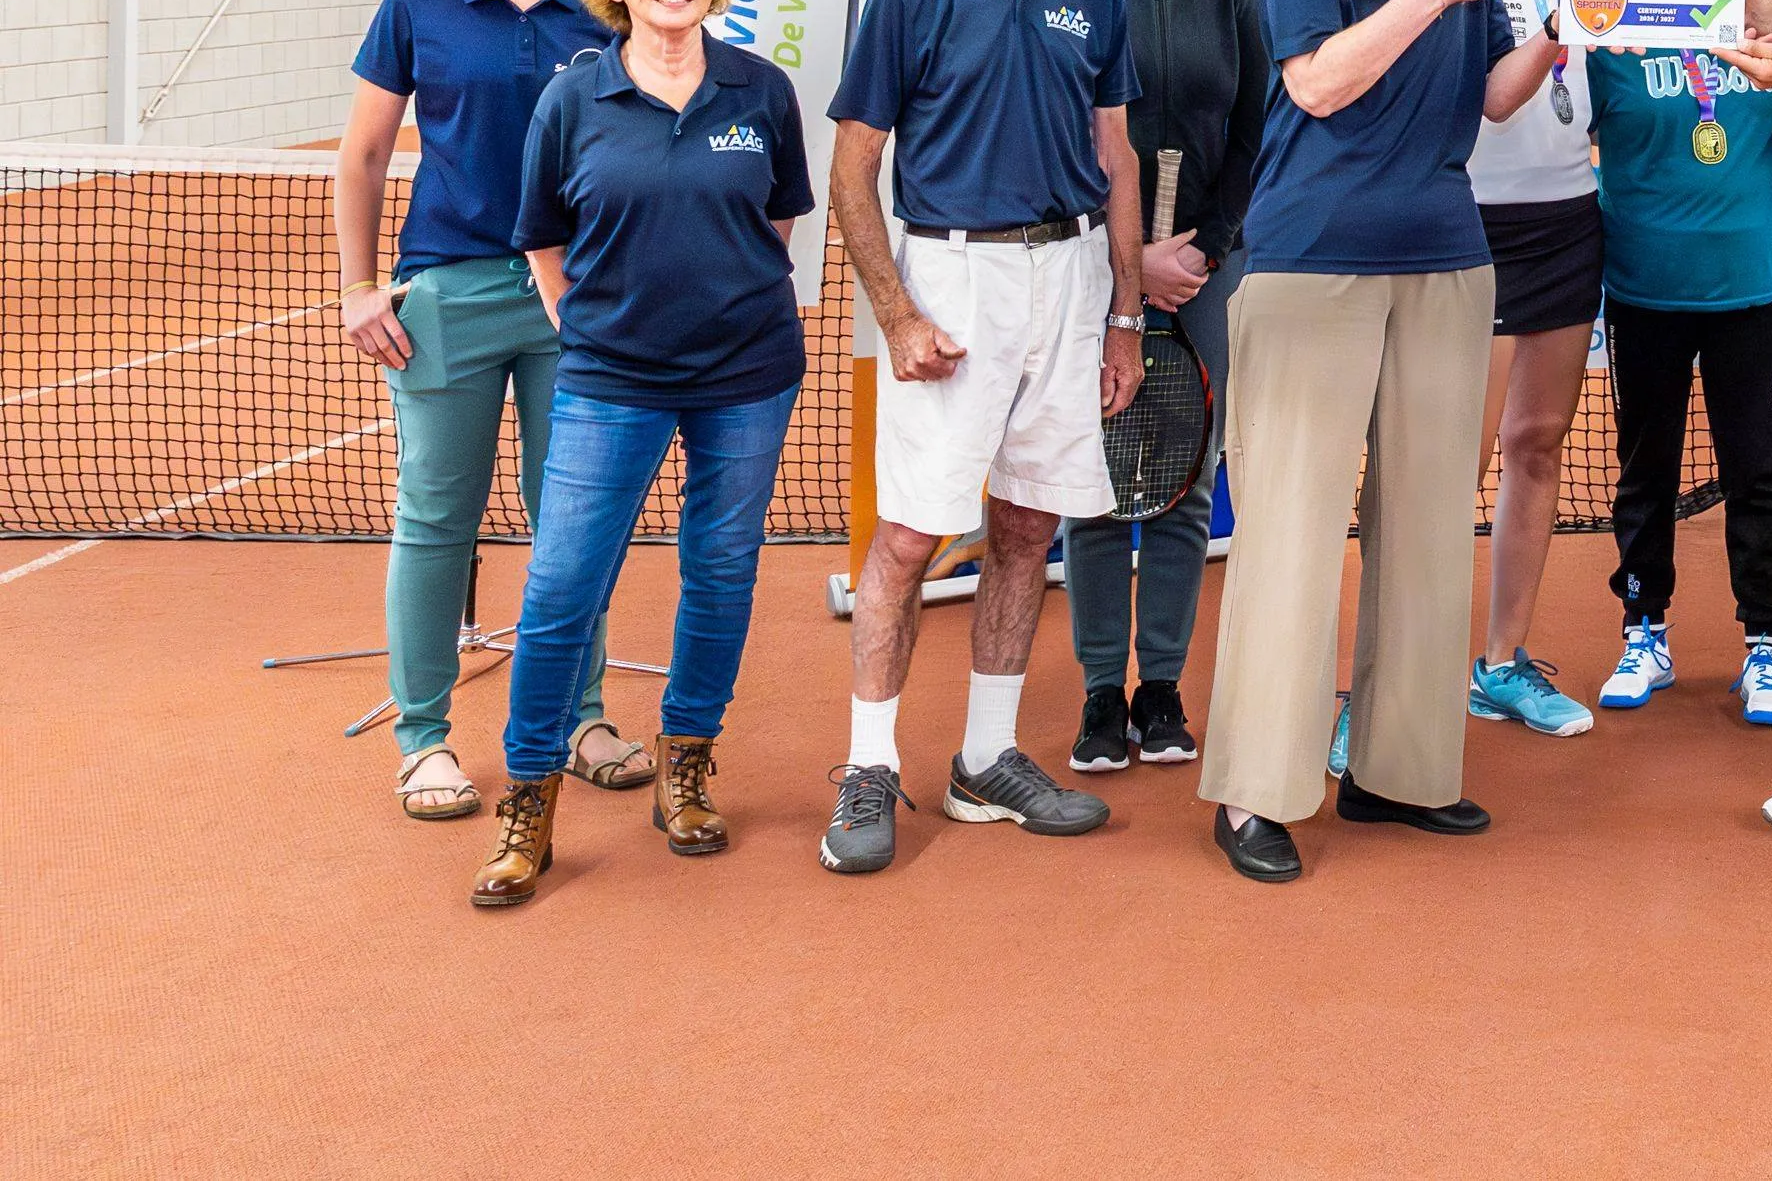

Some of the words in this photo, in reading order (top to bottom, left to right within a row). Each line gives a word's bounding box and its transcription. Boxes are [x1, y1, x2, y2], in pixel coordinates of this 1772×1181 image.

[1576, 0, 1621, 10] SPORTEN
[1637, 7, 1677, 15] CERTIFICAAT
[1044, 9, 1091, 35] WAAG
[773, 23, 804, 69] De
[708, 134, 764, 150] WAAG
